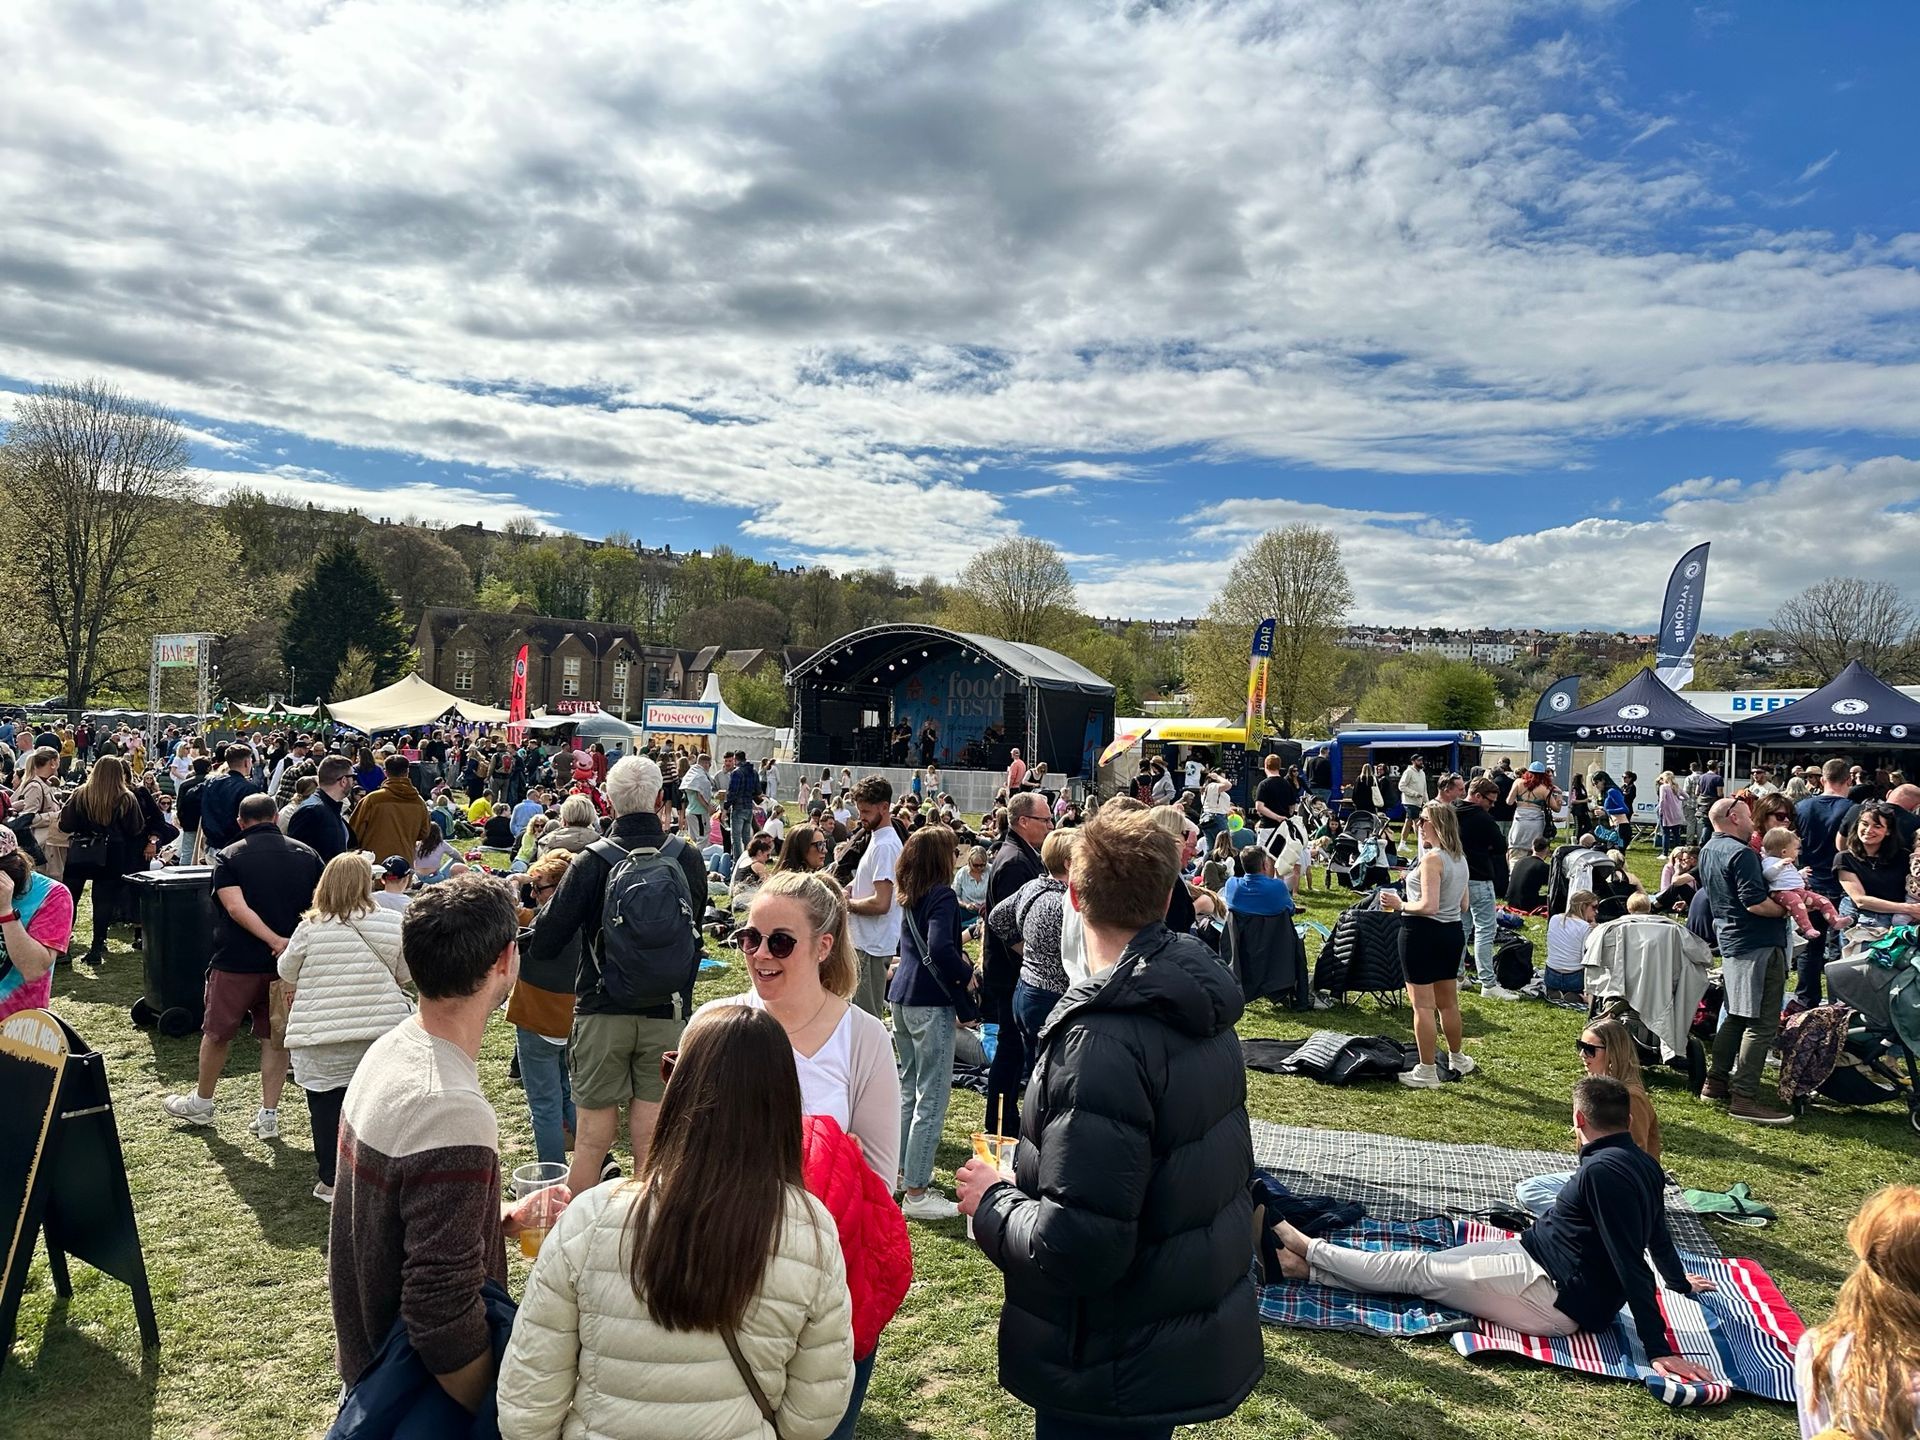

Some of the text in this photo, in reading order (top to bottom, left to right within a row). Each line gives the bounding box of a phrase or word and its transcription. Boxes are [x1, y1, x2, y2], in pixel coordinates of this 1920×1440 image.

[1259, 626, 1272, 651] BAR
[162, 644, 183, 661] BAR
[649, 708, 705, 724] Prosecco
[1595, 724, 1656, 737] SALCOMBE
[1812, 722, 1883, 735] SALCOMBE
[2, 1017, 62, 1055] COCKTAIL MENU
